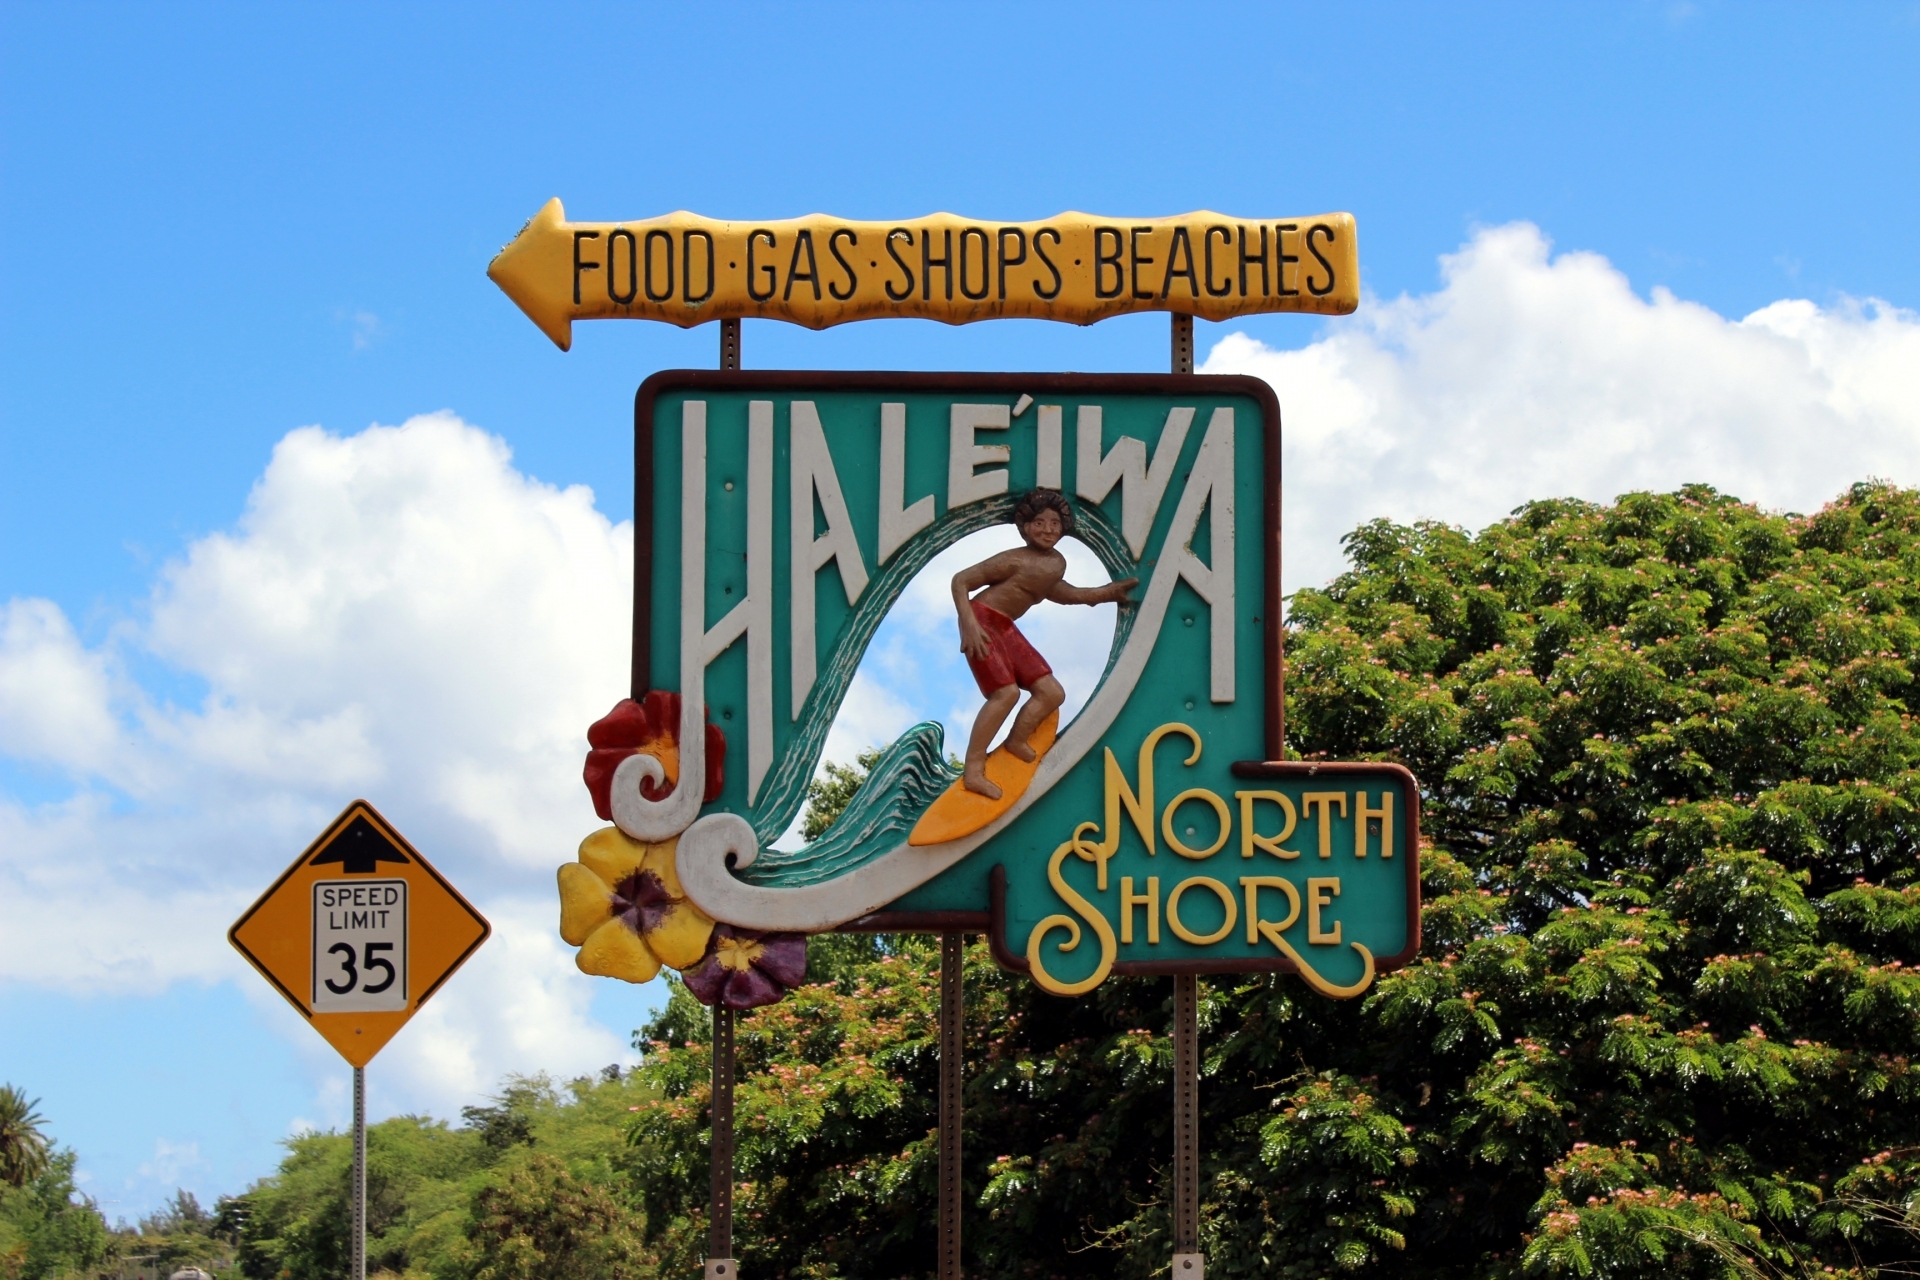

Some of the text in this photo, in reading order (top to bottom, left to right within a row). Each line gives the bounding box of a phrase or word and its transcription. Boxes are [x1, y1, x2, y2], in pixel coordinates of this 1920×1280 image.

[573, 223, 1336, 305] FOOD GAS SHOPS BEACHES
[1073, 722, 1394, 861] NORTH
[322, 887, 398, 907] SPEED
[329, 910, 390, 930] LIMIT
[1027, 839, 1375, 998] SHORE
[324, 942, 396, 995] 35
